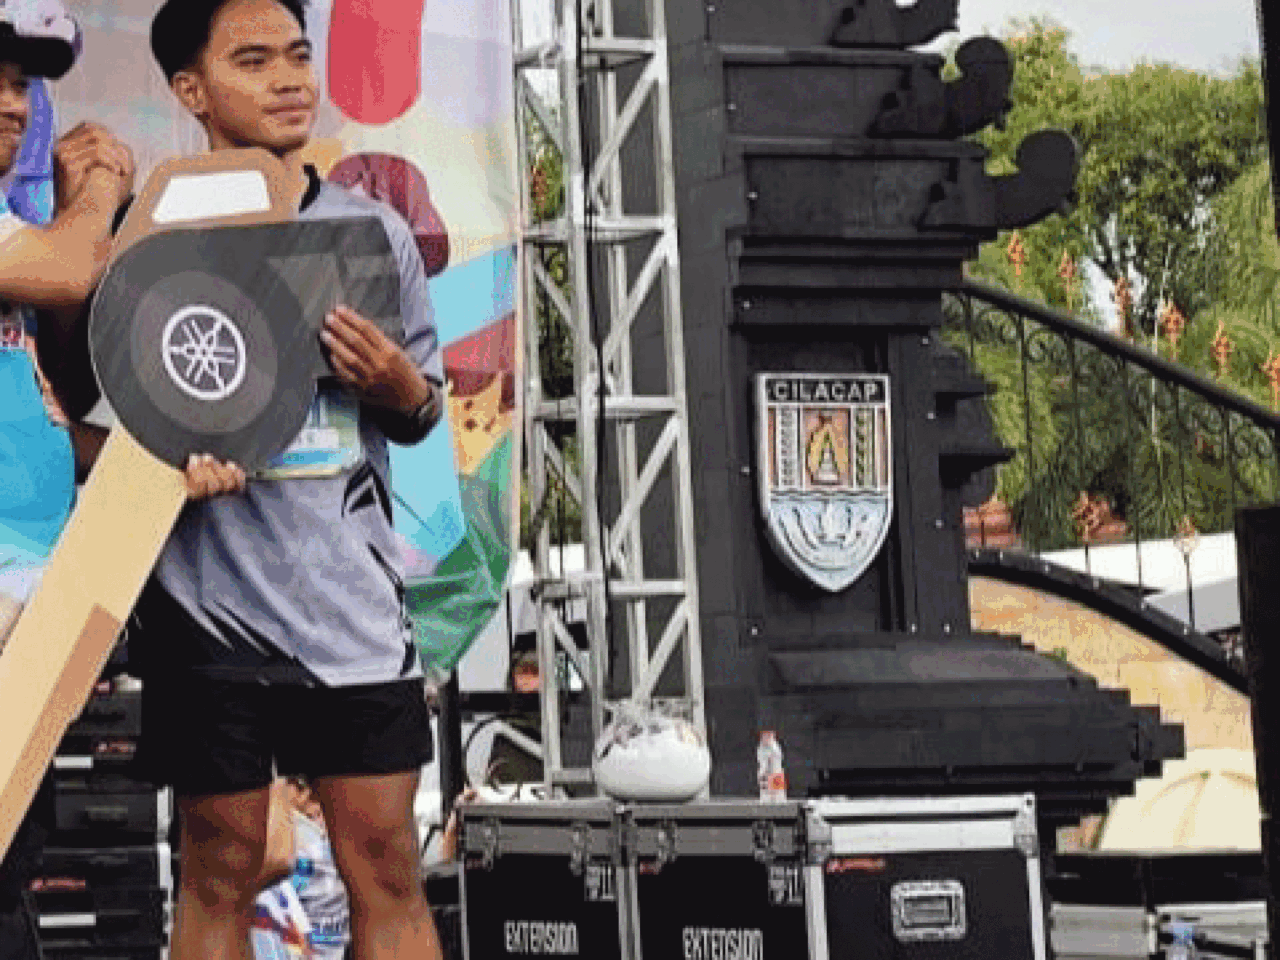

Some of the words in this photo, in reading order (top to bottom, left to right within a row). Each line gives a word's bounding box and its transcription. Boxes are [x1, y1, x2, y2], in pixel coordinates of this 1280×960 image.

[774, 382, 879, 401] CILACAP
[504, 920, 580, 955] EXTENSION
[682, 926, 764, 960] EXTENSION
